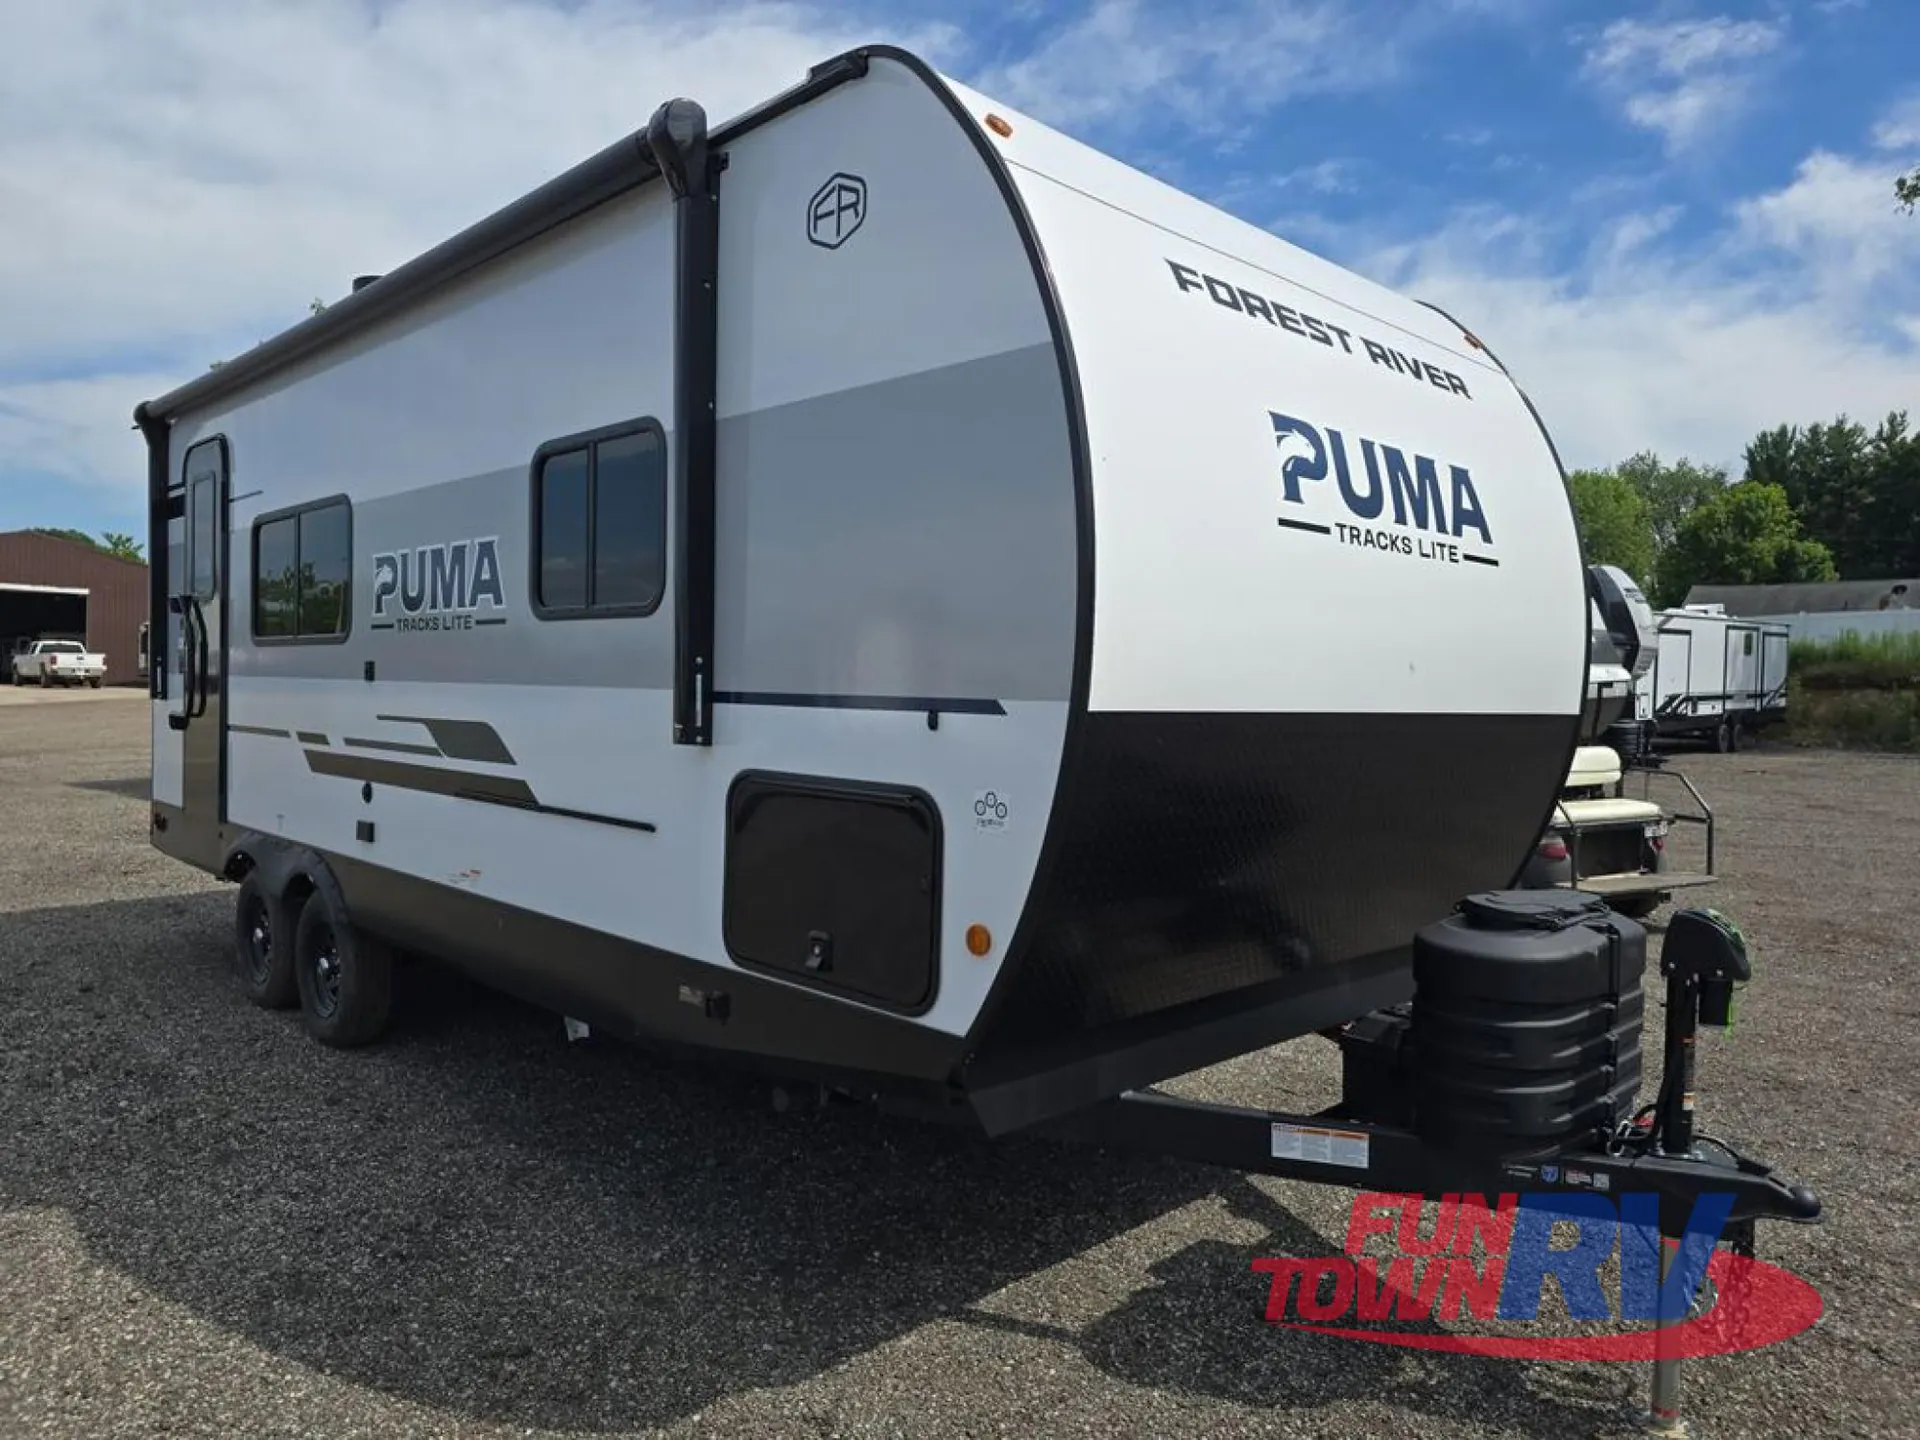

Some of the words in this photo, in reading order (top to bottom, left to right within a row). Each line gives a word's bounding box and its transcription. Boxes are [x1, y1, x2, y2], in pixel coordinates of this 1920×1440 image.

[1164, 257, 1352, 355] FOREST
[1359, 336, 1473, 401] RIVER
[1267, 409, 1493, 545] PUMA
[372, 535, 506, 616] PUMA
[1334, 523, 1413, 555] TRACKS
[1419, 538, 1460, 564] LITE
[396, 617, 440, 633] TRACKS
[441, 615, 473, 631] LITE
